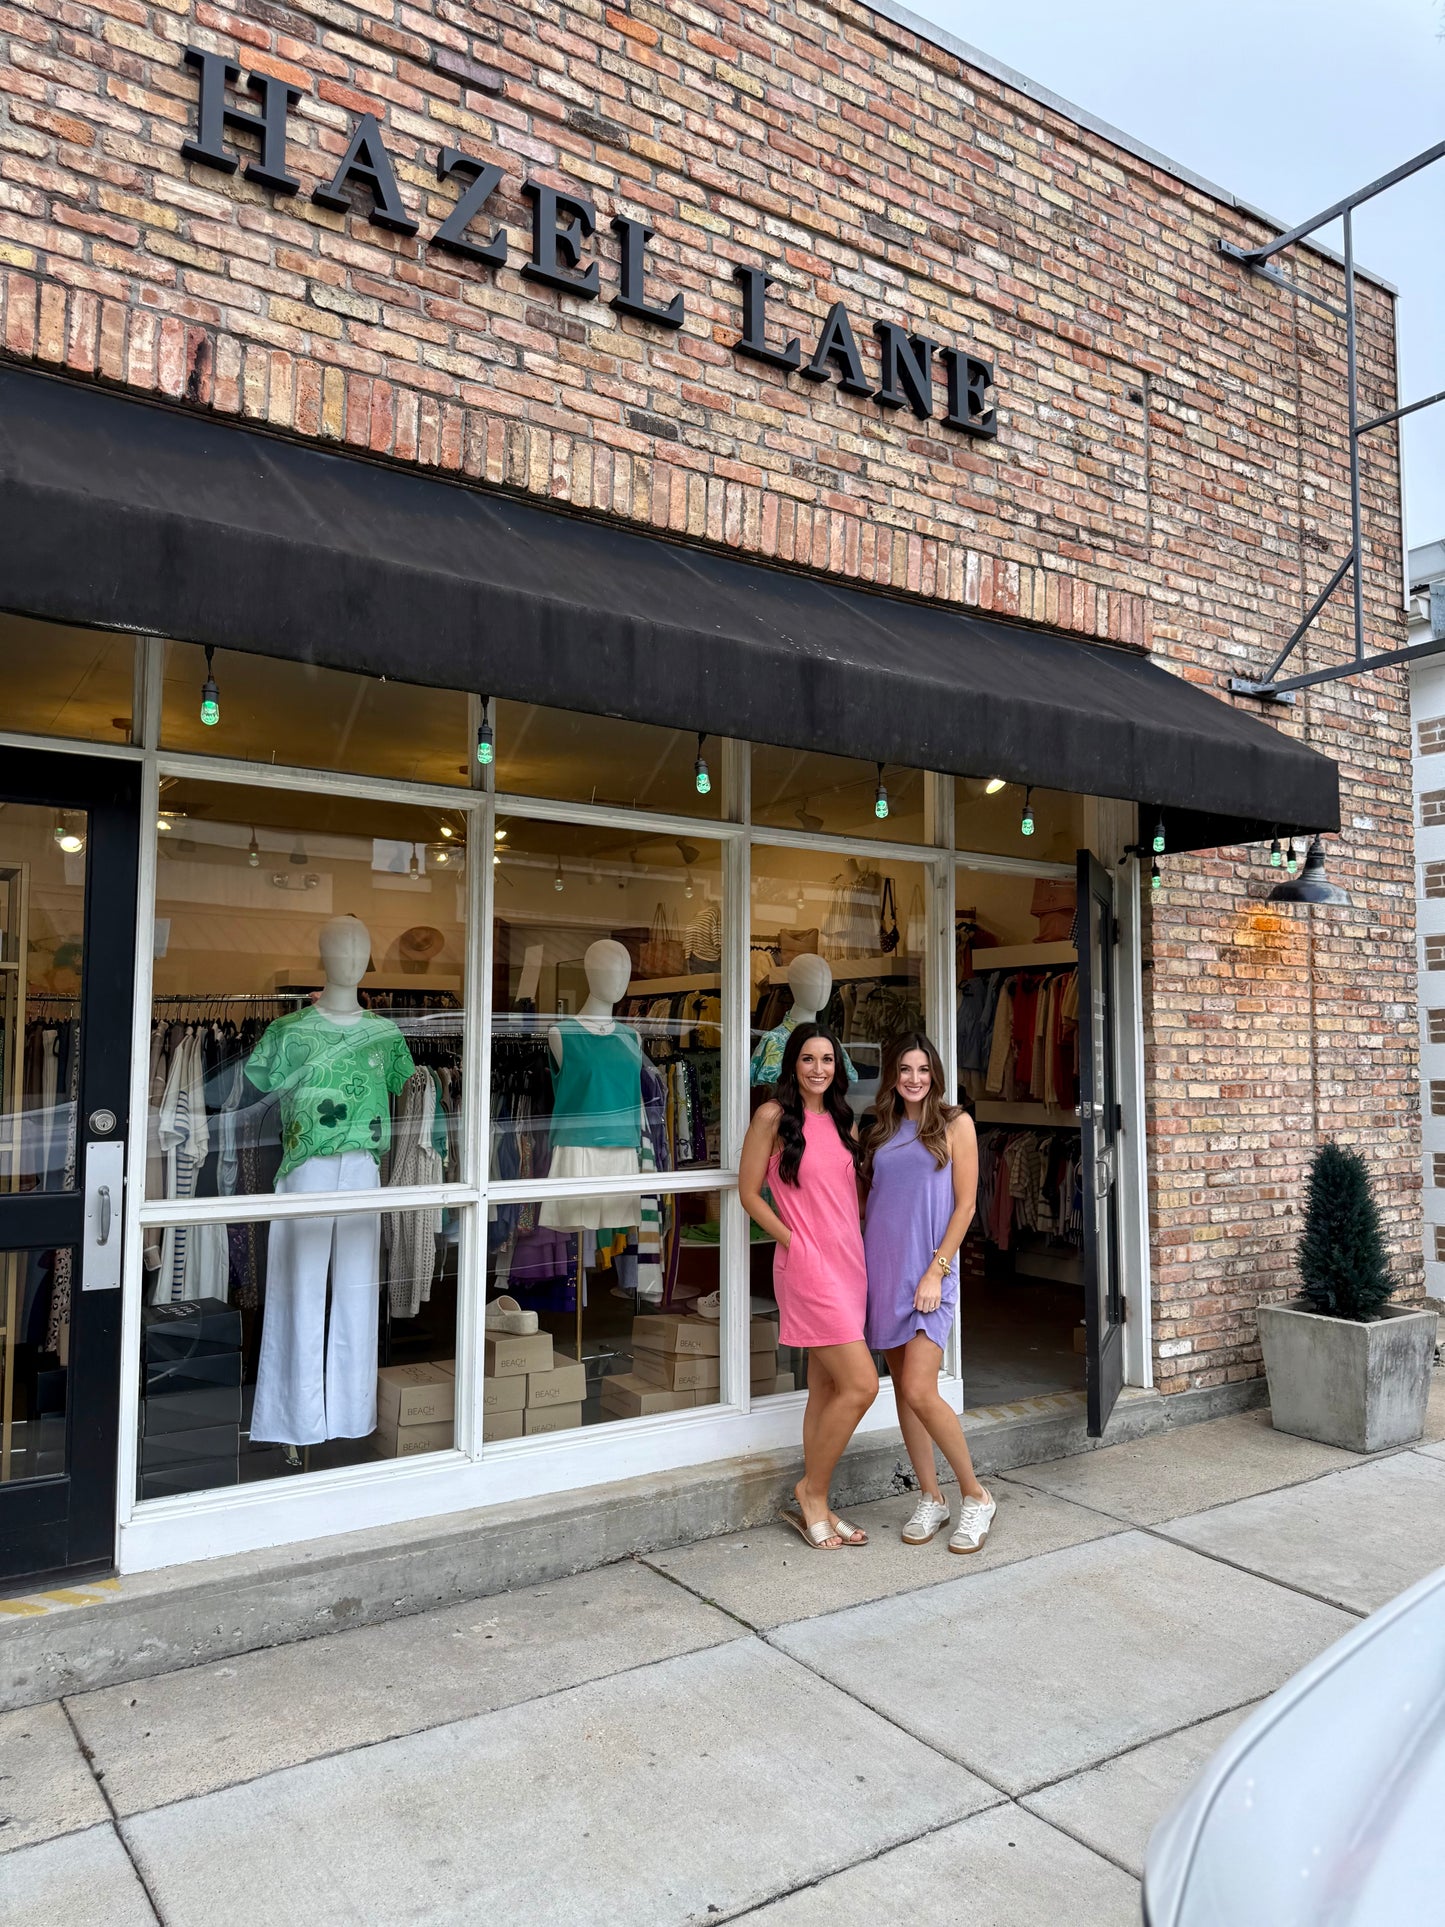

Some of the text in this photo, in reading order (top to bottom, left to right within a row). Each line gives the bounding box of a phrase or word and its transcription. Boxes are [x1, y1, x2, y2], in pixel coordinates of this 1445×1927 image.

[181, 46, 997, 439] HAZEL LANE
[501, 1358, 526, 1368] BEACH
[535, 1388, 560, 1398] BEACH
[407, 1405, 435, 1416] BEACH
[531, 1423, 556, 1433] BEACH
[403, 1441, 430, 1451] BEACH
